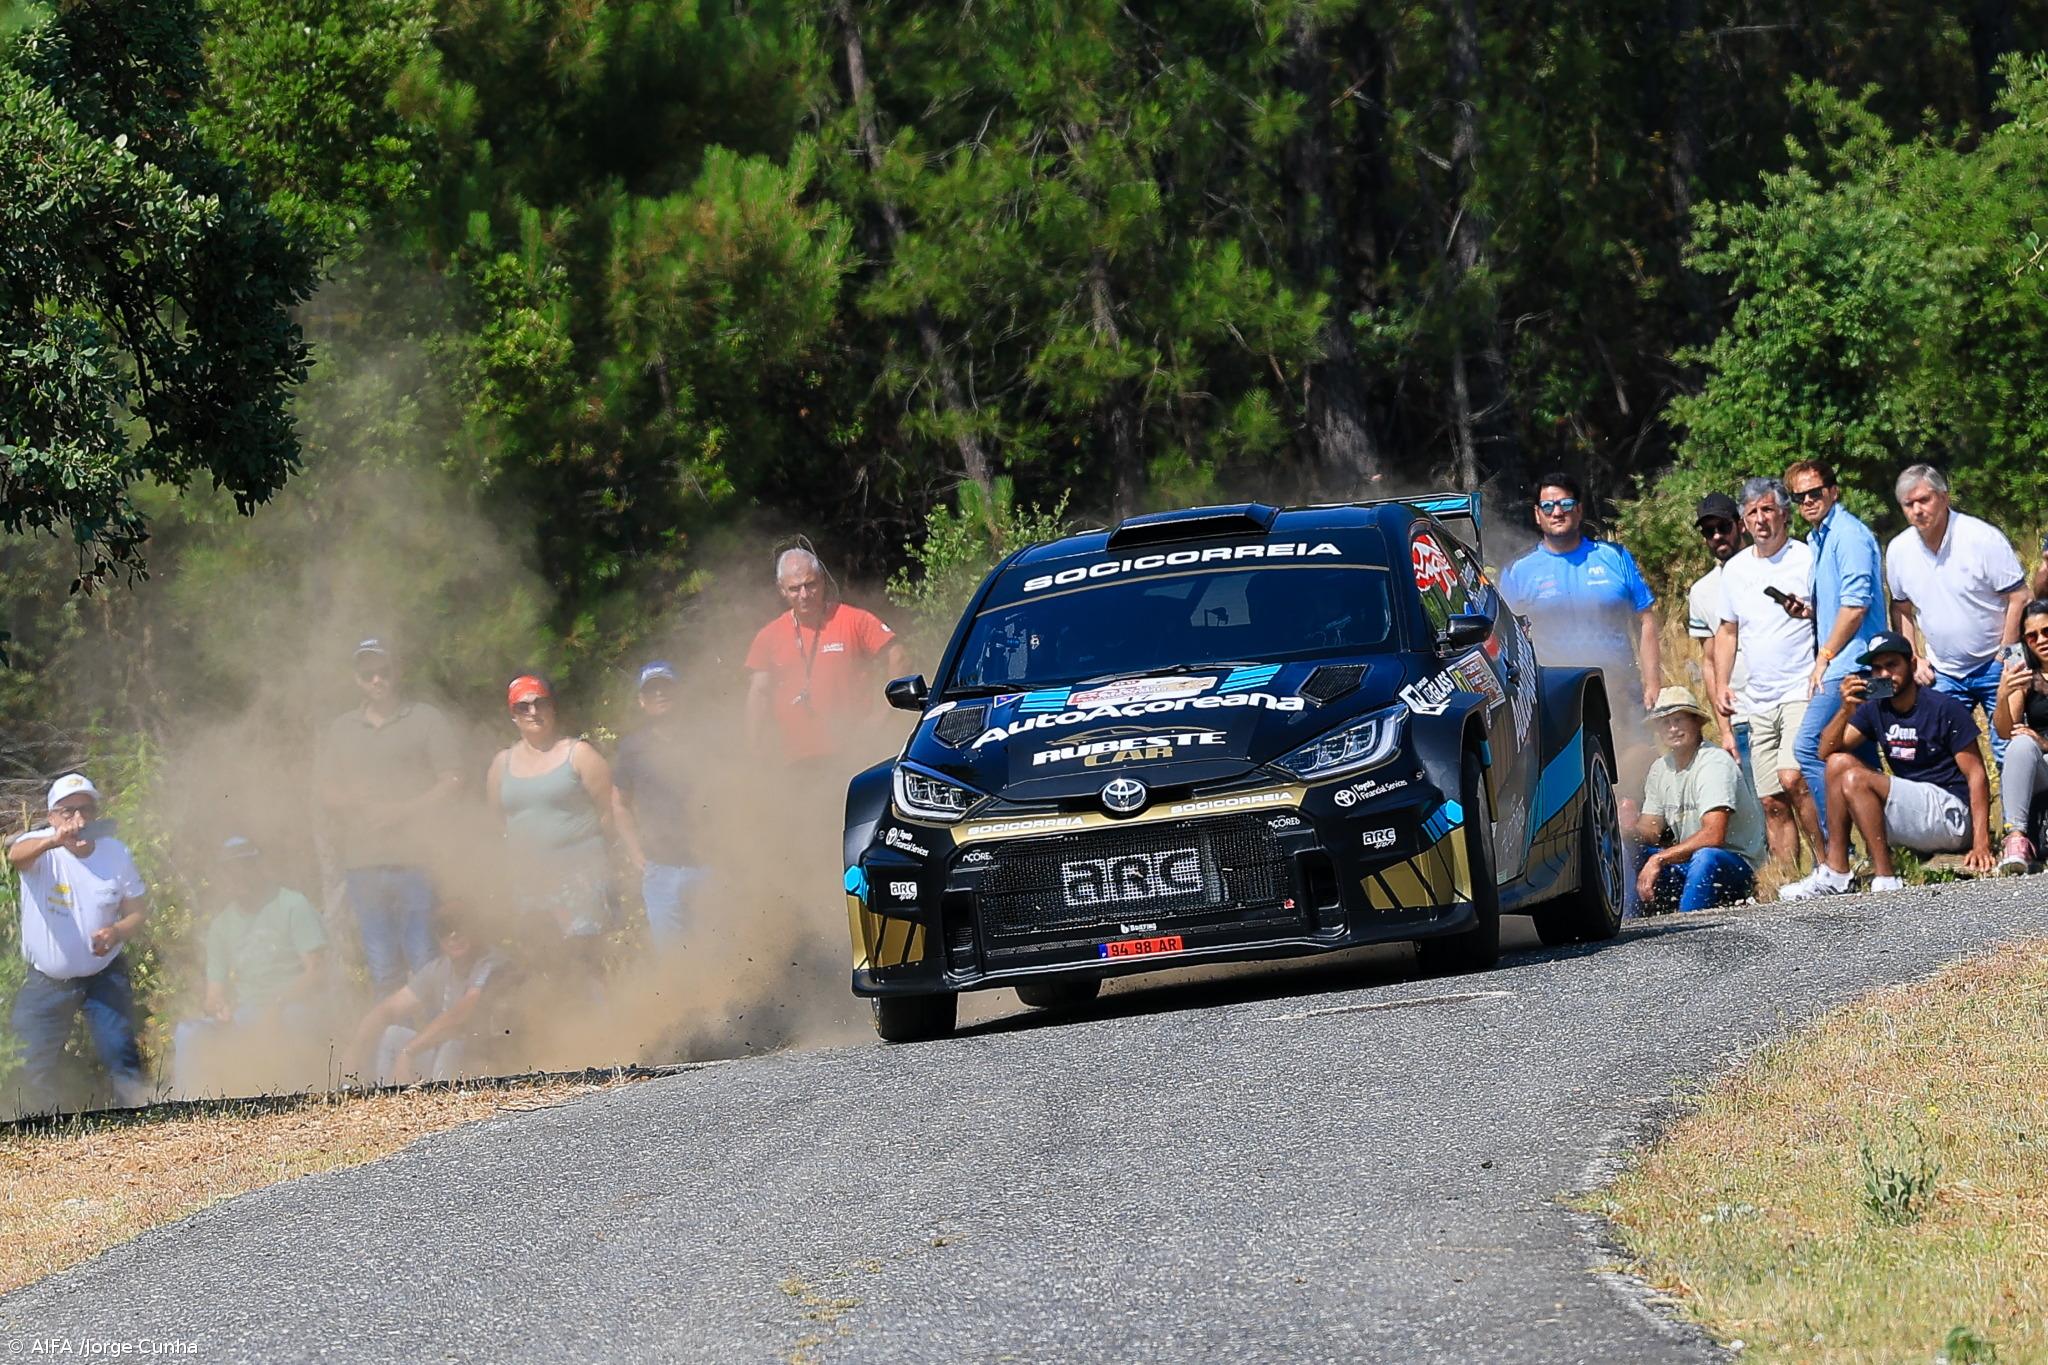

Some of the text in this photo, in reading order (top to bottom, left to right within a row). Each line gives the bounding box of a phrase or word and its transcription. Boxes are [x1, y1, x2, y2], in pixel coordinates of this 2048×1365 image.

[1023, 543, 1342, 592] SOCICORREIA
[971, 692, 1305, 749] AutoAçoreana
[1032, 731, 1227, 766] RUBESTE
[1084, 746, 1173, 767] CAR
[1354, 779, 1376, 793] Toyota
[1361, 779, 1408, 800] Financial Services
[1170, 792, 1293, 814] SOCICORREIA
[967, 817, 1084, 836] SOCICORREIA
[1111, 943, 1128, 956] 94
[1135, 941, 1152, 954] 98
[1159, 939, 1177, 952] AR
